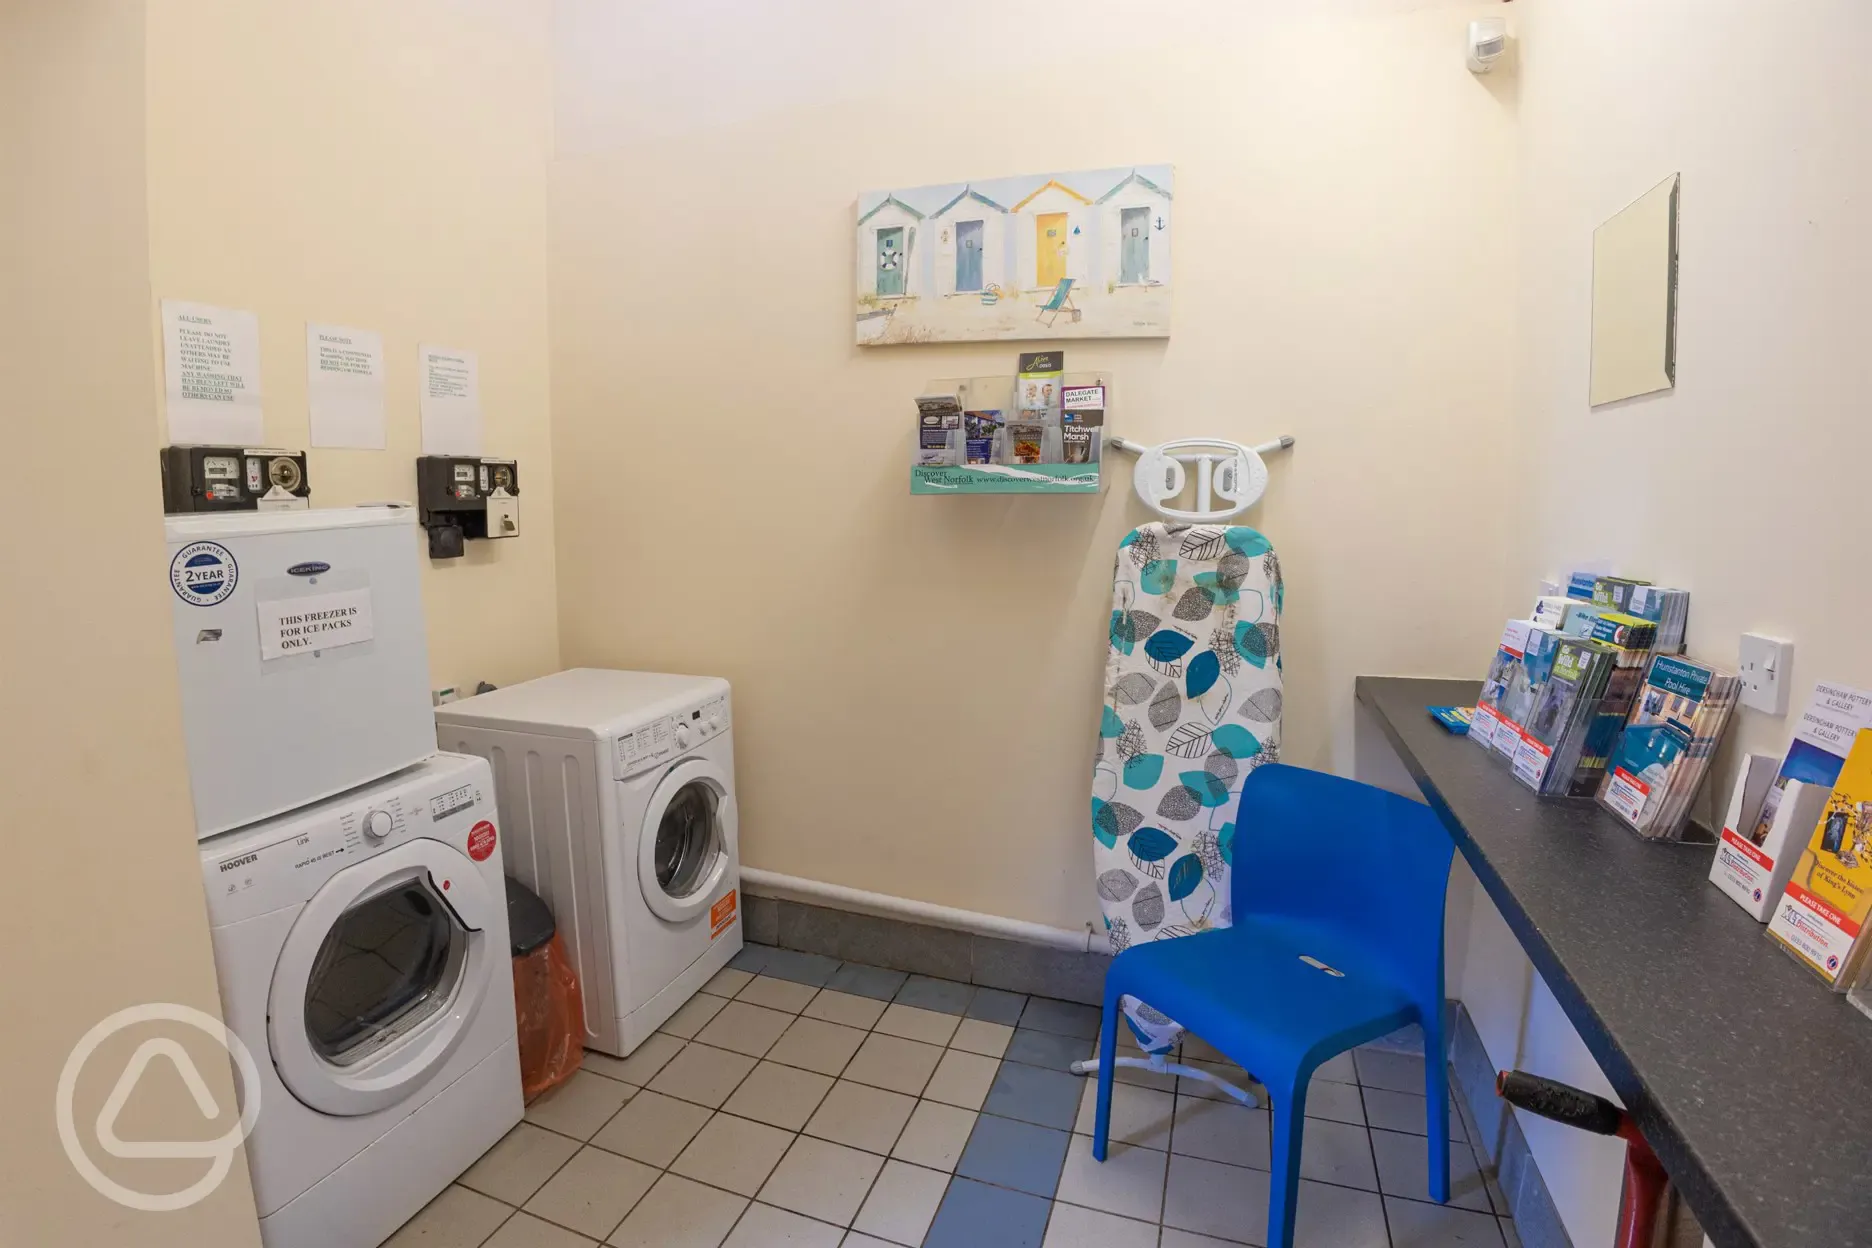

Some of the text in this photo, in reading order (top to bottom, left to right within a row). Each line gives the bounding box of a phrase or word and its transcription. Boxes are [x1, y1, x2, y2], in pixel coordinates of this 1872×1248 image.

[1066, 389, 1098, 397] DALEGATE
[1064, 425, 1099, 433] Titchwell
[1064, 432, 1089, 440] Marsh
[914, 470, 947, 478] Discover
[924, 476, 943, 484] West
[944, 475, 973, 484] Norfolk
[182, 545, 224, 559] GUARANTEE
[174, 570, 202, 603] GUARANTEE
[214, 563, 234, 601] GUARANTEE
[279, 607, 357, 626] THIS FREEZER IS
[280, 620, 352, 638] FOR ICE PACKS
[282, 637, 312, 649] ONLY.
[1558, 654, 1574, 668] Wild
[1655, 660, 1708, 684] Hunstanton Private
[1664, 678, 1691, 695] Pool Hire
[1816, 684, 1848, 700] DERSINGHAM
[1832, 700, 1853, 710] GALLERY
[1804, 712, 1835, 728] DERSINGHAM
[1818, 729, 1841, 741] GALLERY
[220, 854, 258, 872] HOOVER
[1824, 875, 1841, 890] King's
[1842, 886, 1855, 899] Lynn
[1799, 893, 1818, 910] PLEASE
[1817, 903, 1830, 917] TAKE
[1829, 912, 1842, 925] ONE
